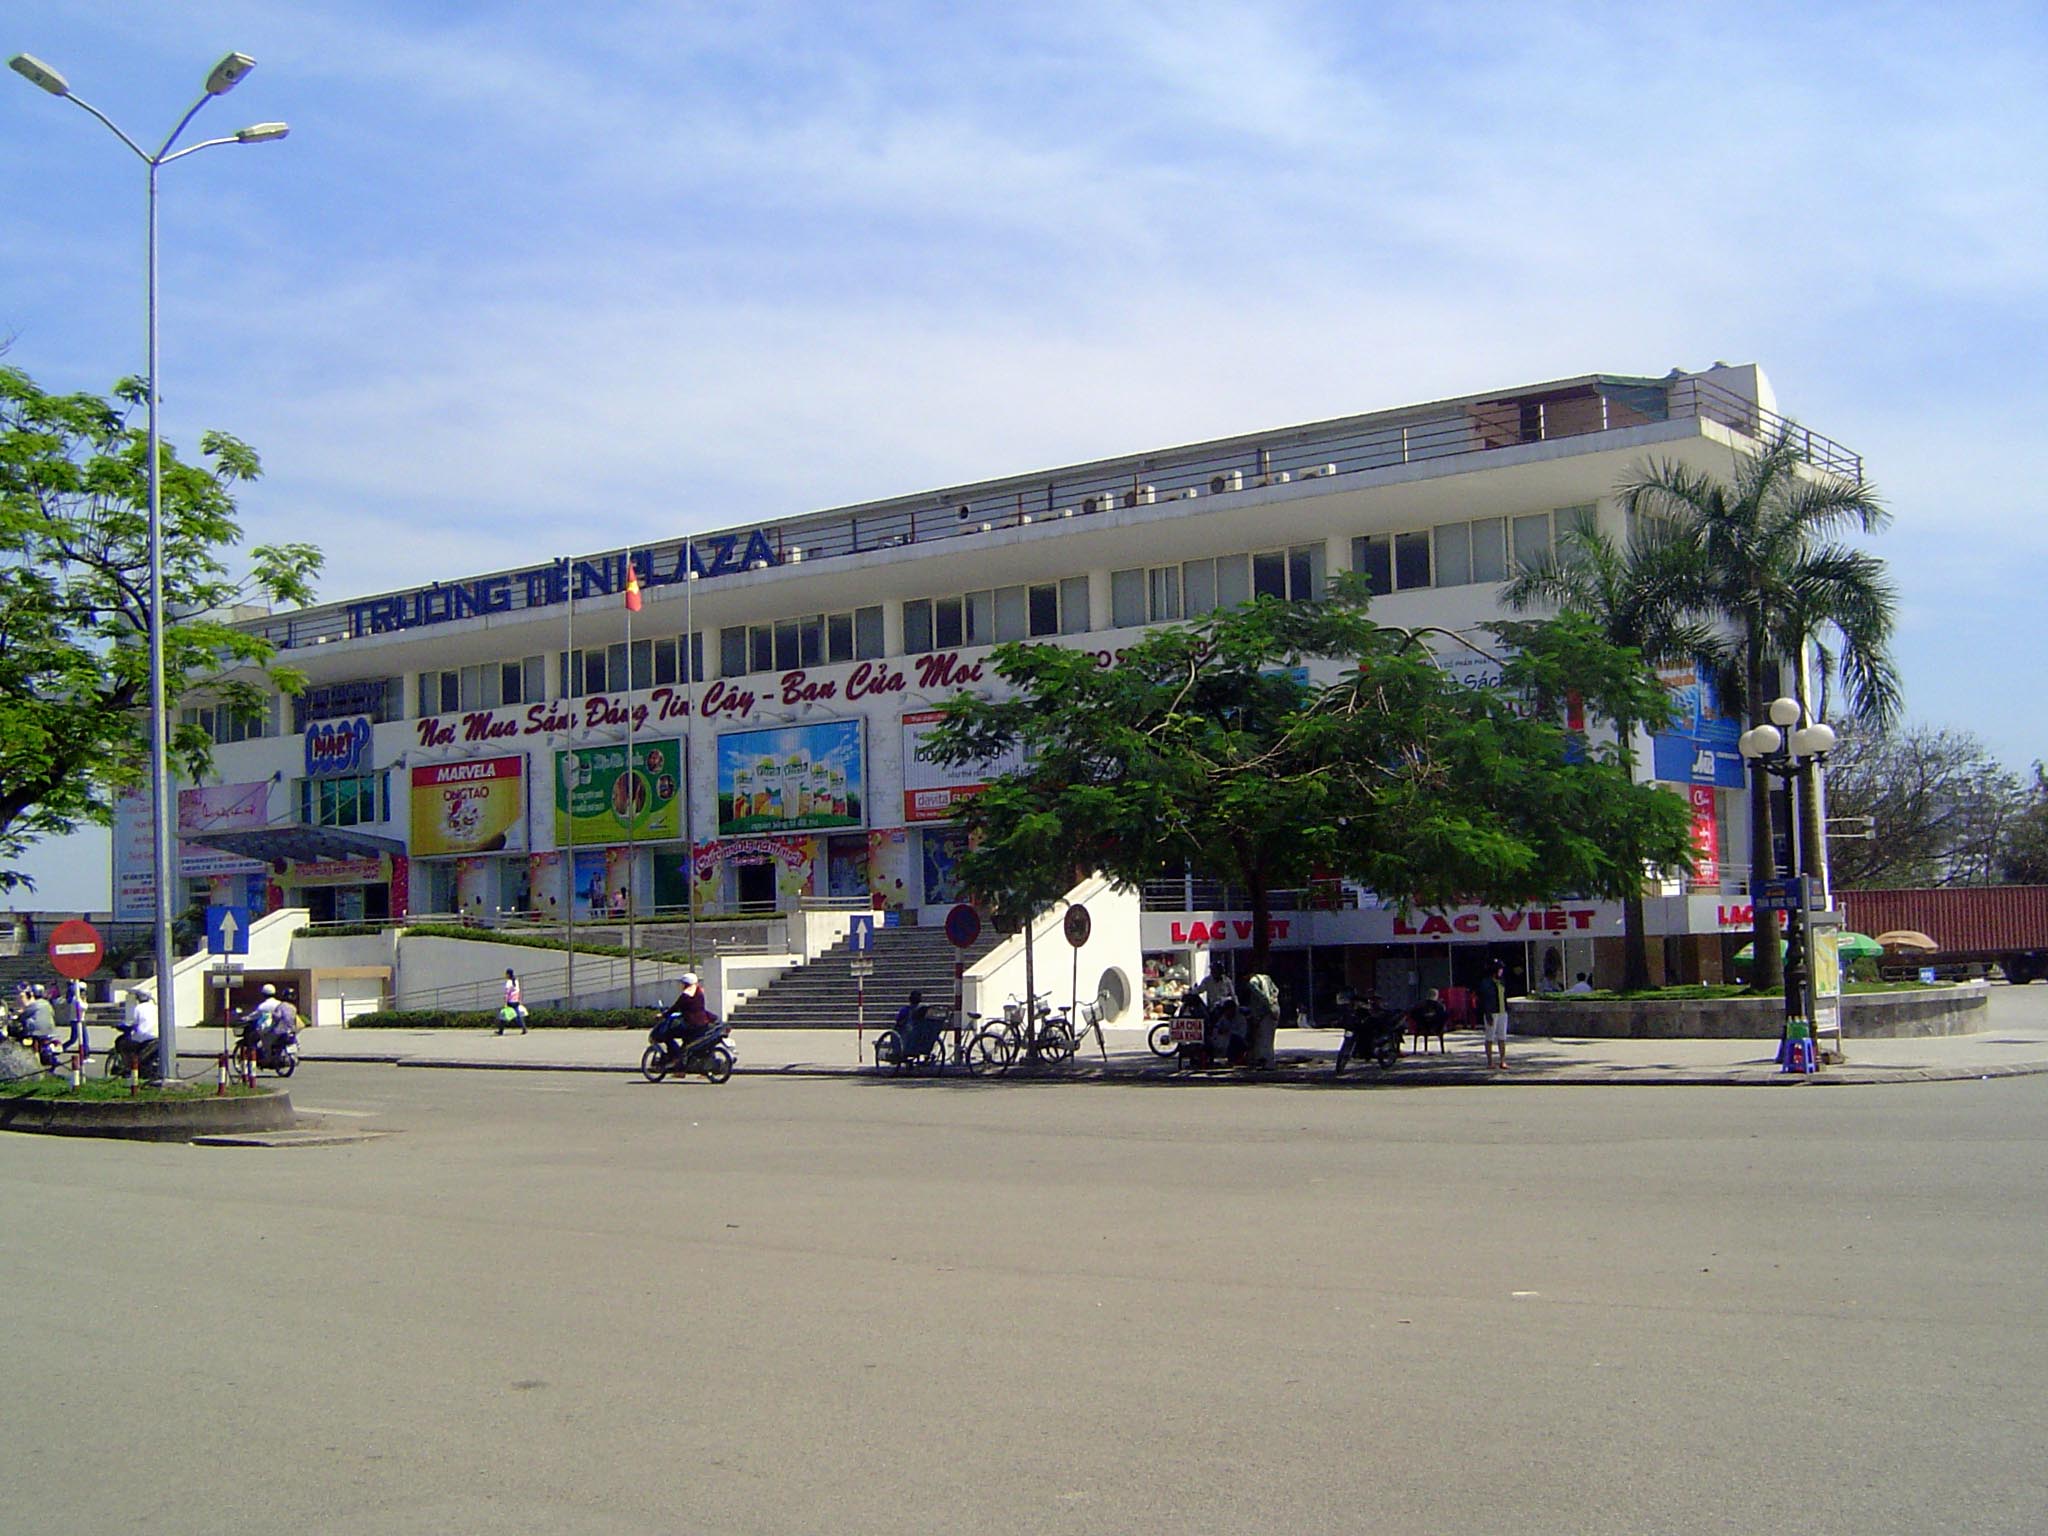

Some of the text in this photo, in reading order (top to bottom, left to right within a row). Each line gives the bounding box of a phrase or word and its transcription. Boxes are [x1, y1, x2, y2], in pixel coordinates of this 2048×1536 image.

[617, 529, 783, 592] PLAZA
[462, 711, 519, 741] Mua
[585, 697, 649, 731] Đáng
[652, 688, 694, 721] Tin
[701, 681, 755, 719] Cậy
[846, 662, 906, 701] Của
[915, 653, 984, 693] Mọi
[314, 732, 354, 757] MART
[437, 763, 496, 781] MARVELA
[1171, 920, 1227, 948] LẠC
[1393, 905, 1595, 939] LẠC VIỆT
